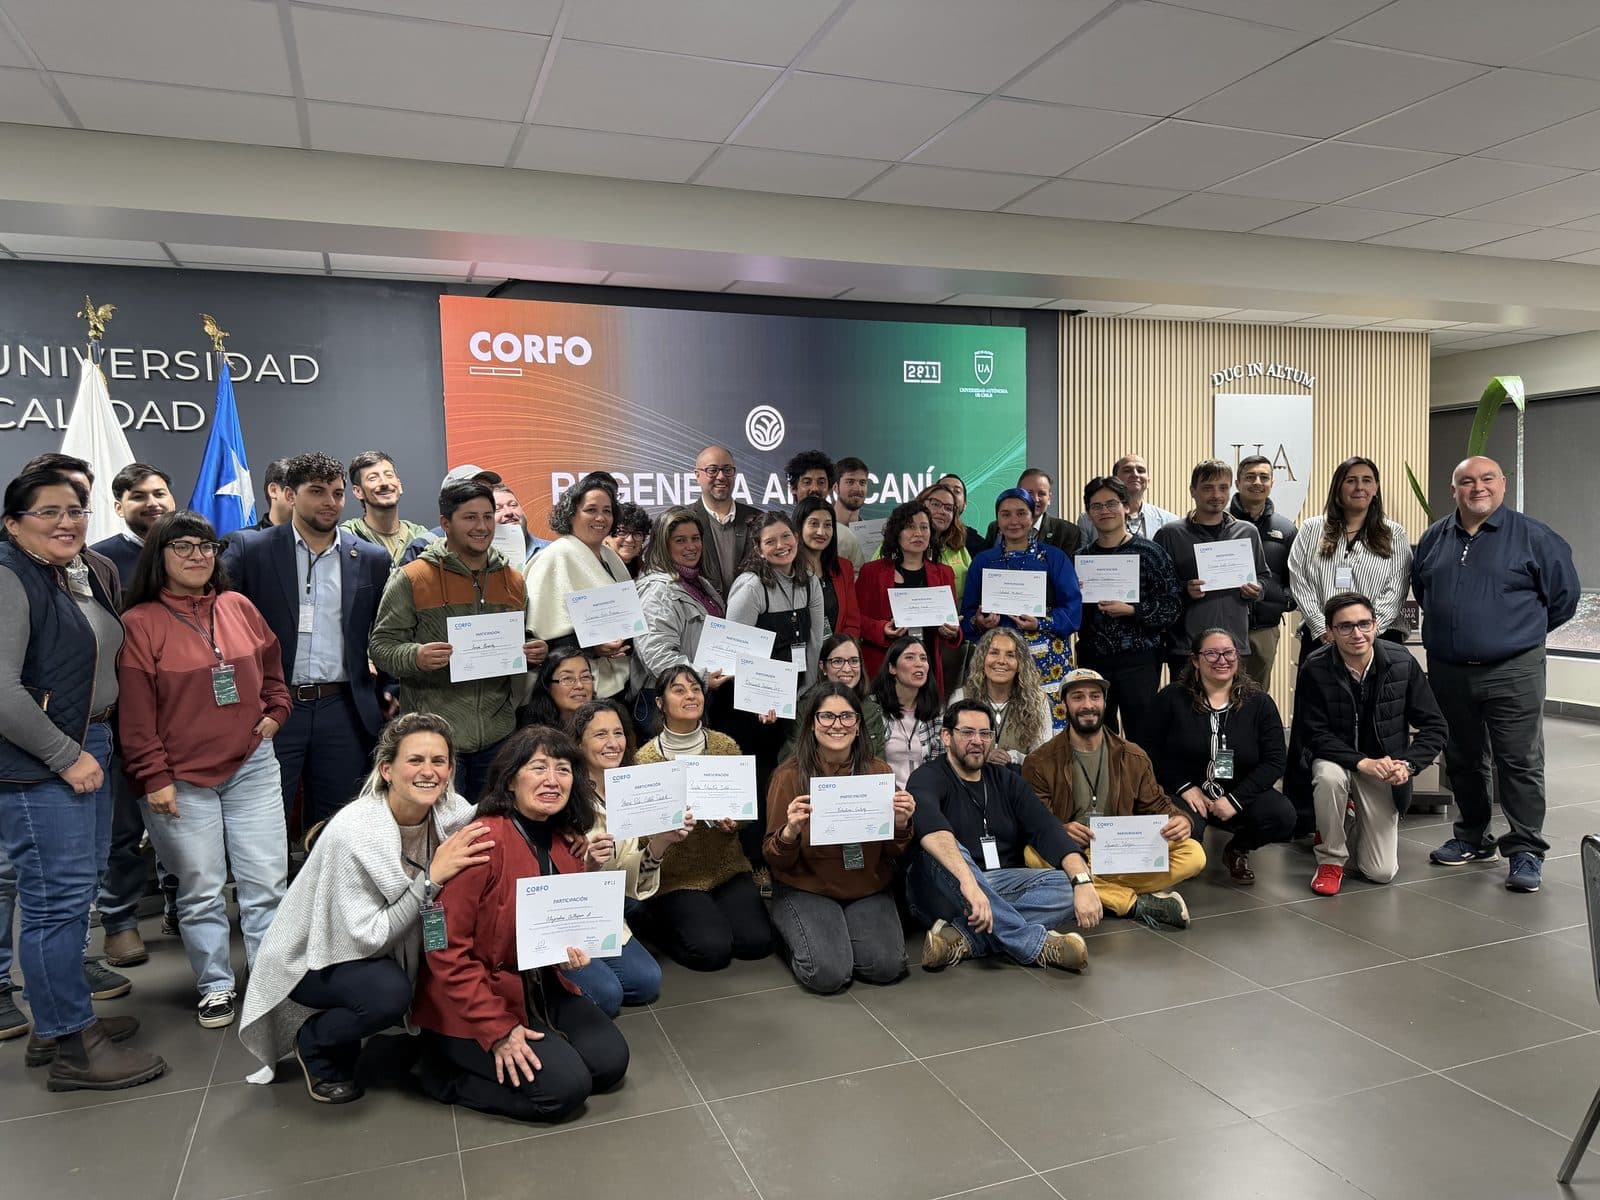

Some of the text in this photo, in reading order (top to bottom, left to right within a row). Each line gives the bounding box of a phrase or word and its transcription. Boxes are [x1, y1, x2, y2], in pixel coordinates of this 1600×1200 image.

[469, 331, 592, 366] CORFO
[1212, 362, 1315, 388] DUC IN ALTUM
[526, 884, 549, 894] CORFO
